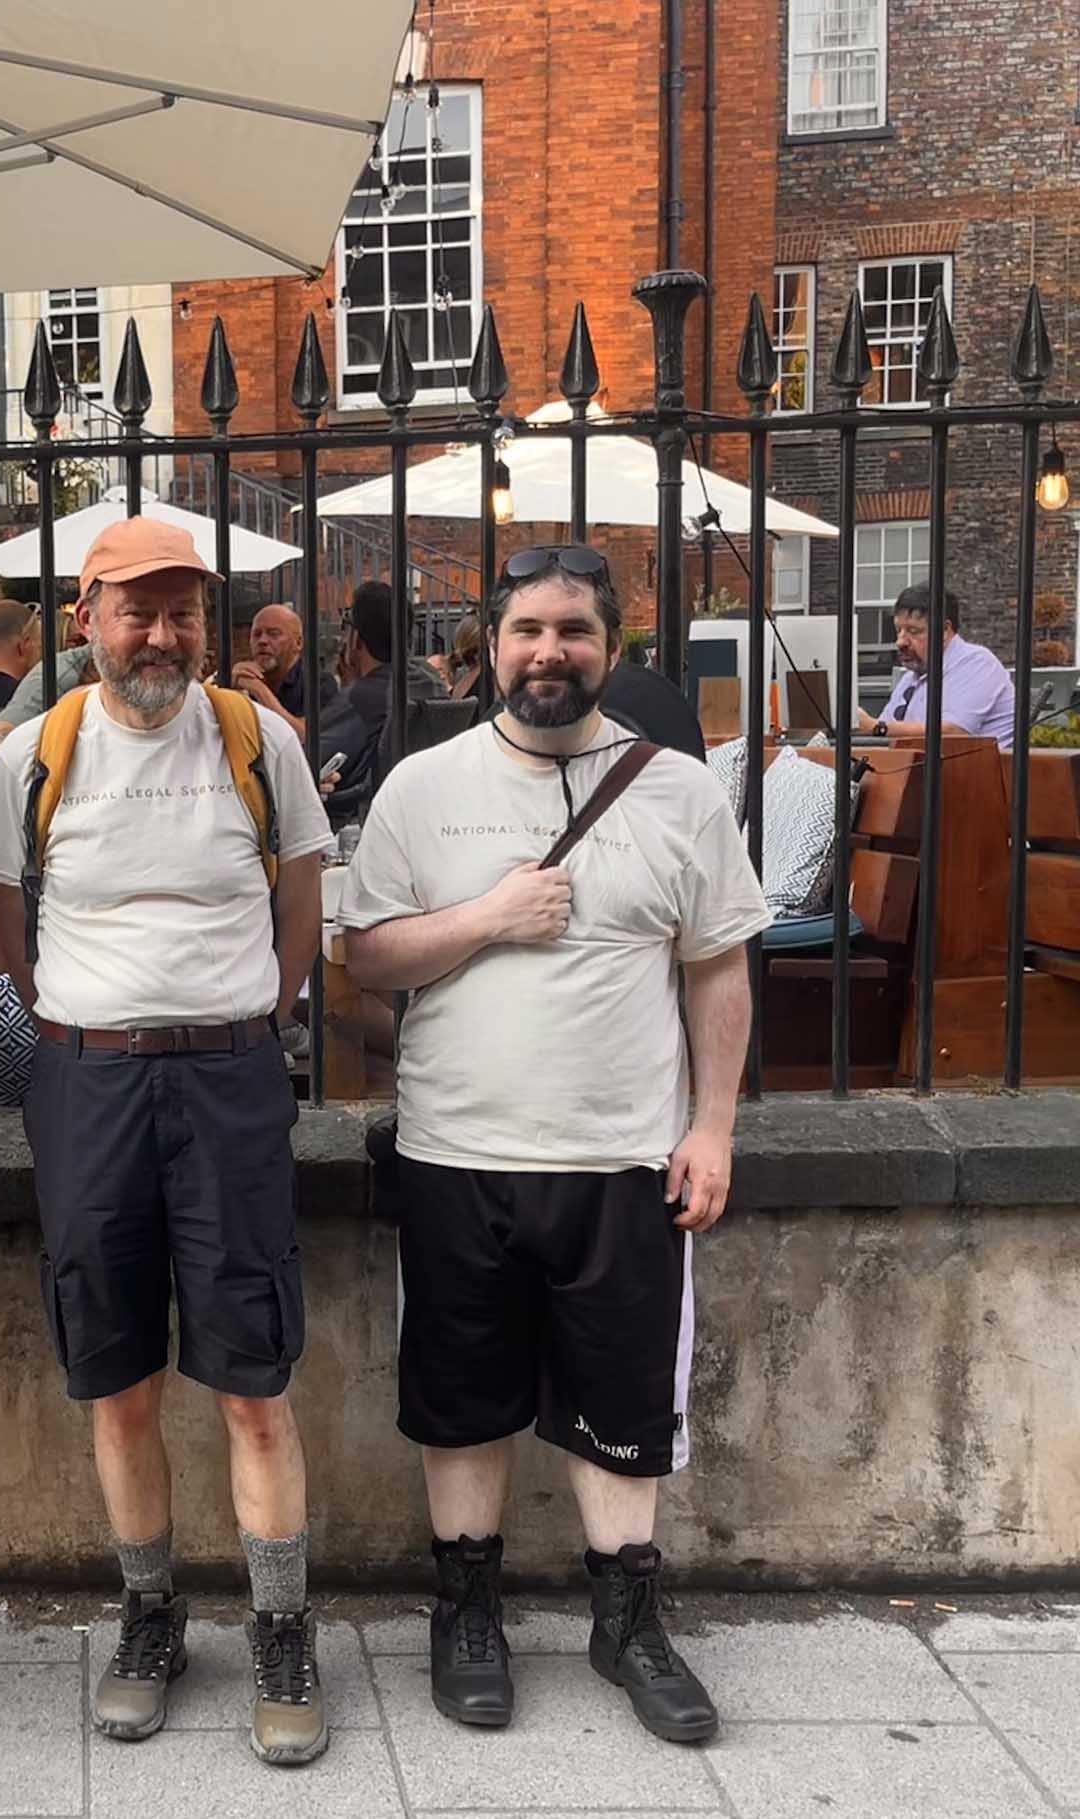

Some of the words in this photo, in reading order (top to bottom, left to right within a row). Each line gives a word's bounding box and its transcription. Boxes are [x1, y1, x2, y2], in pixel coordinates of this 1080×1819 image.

[62, 792, 117, 806] ATIONAL
[125, 786, 172, 799] LEGAL
[180, 783, 234, 797] SERVCE
[440, 825, 516, 837] NATIONAL
